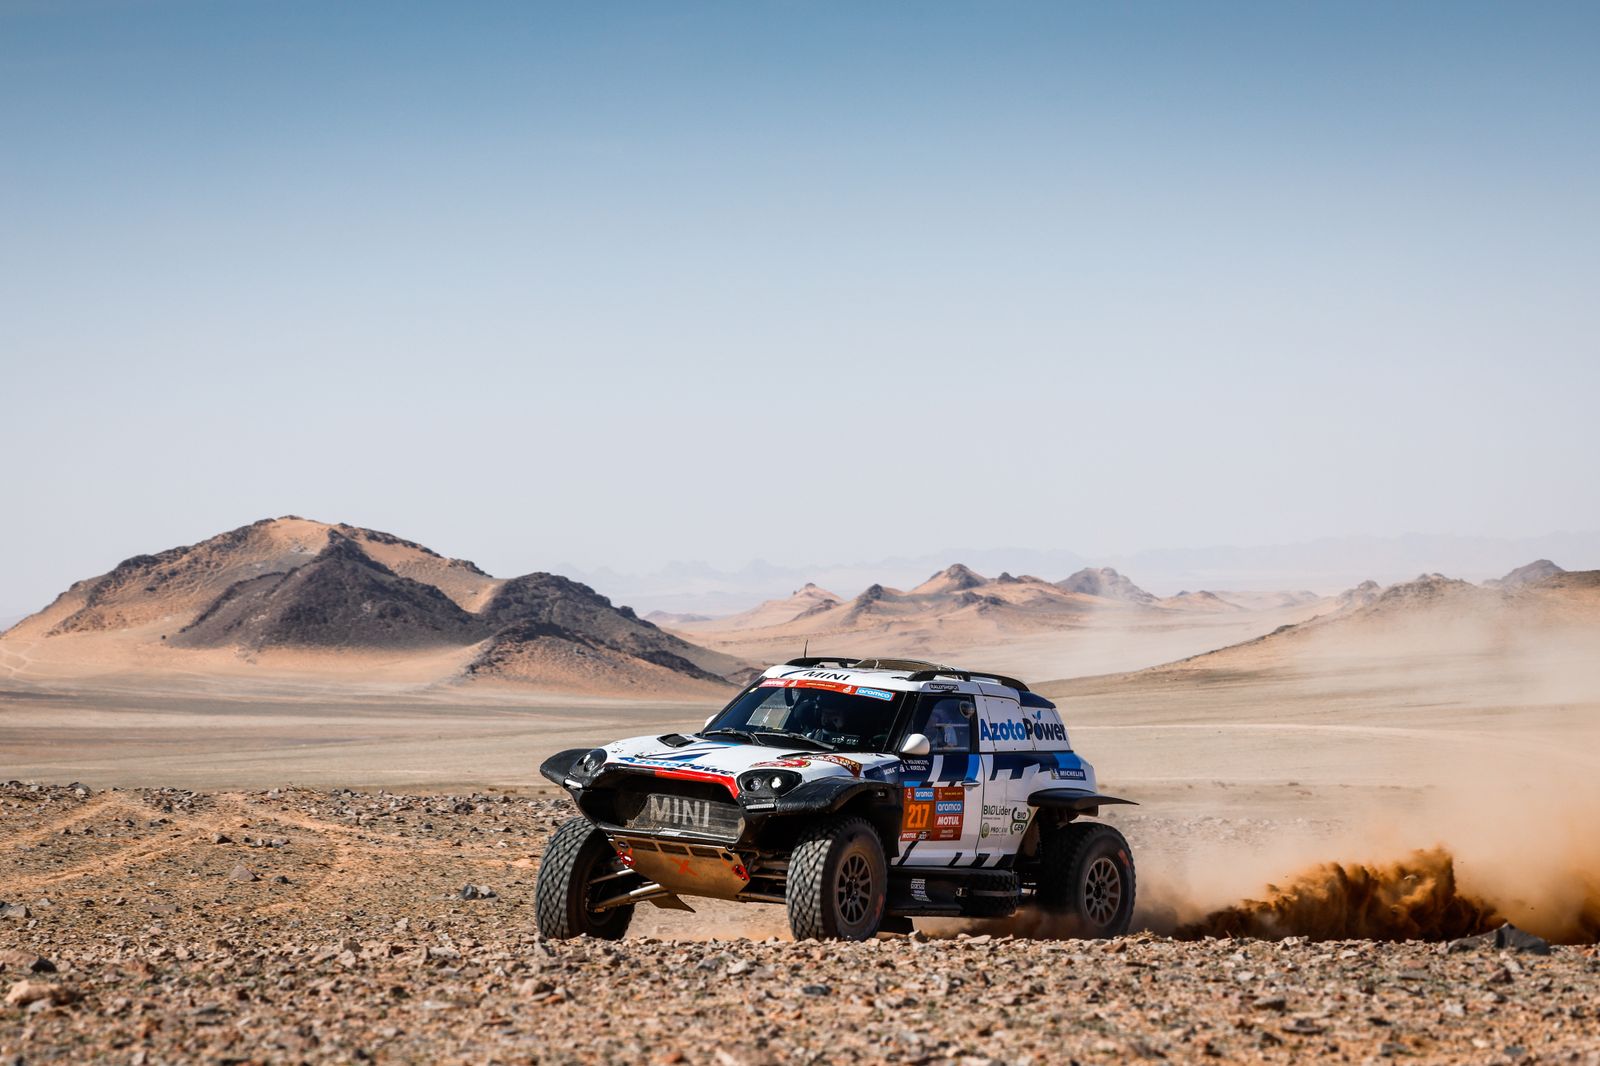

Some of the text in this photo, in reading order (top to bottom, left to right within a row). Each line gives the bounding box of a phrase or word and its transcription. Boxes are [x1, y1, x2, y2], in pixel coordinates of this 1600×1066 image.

[803, 671, 851, 681] MINI
[858, 688, 891, 699] aramco
[980, 717, 1067, 741] AzotoPower
[649, 796, 710, 828] MINI
[937, 804, 962, 812] aramco
[906, 803, 930, 829] 217
[1016, 811, 1027, 819] BIO
[936, 816, 960, 826] MOTUL
